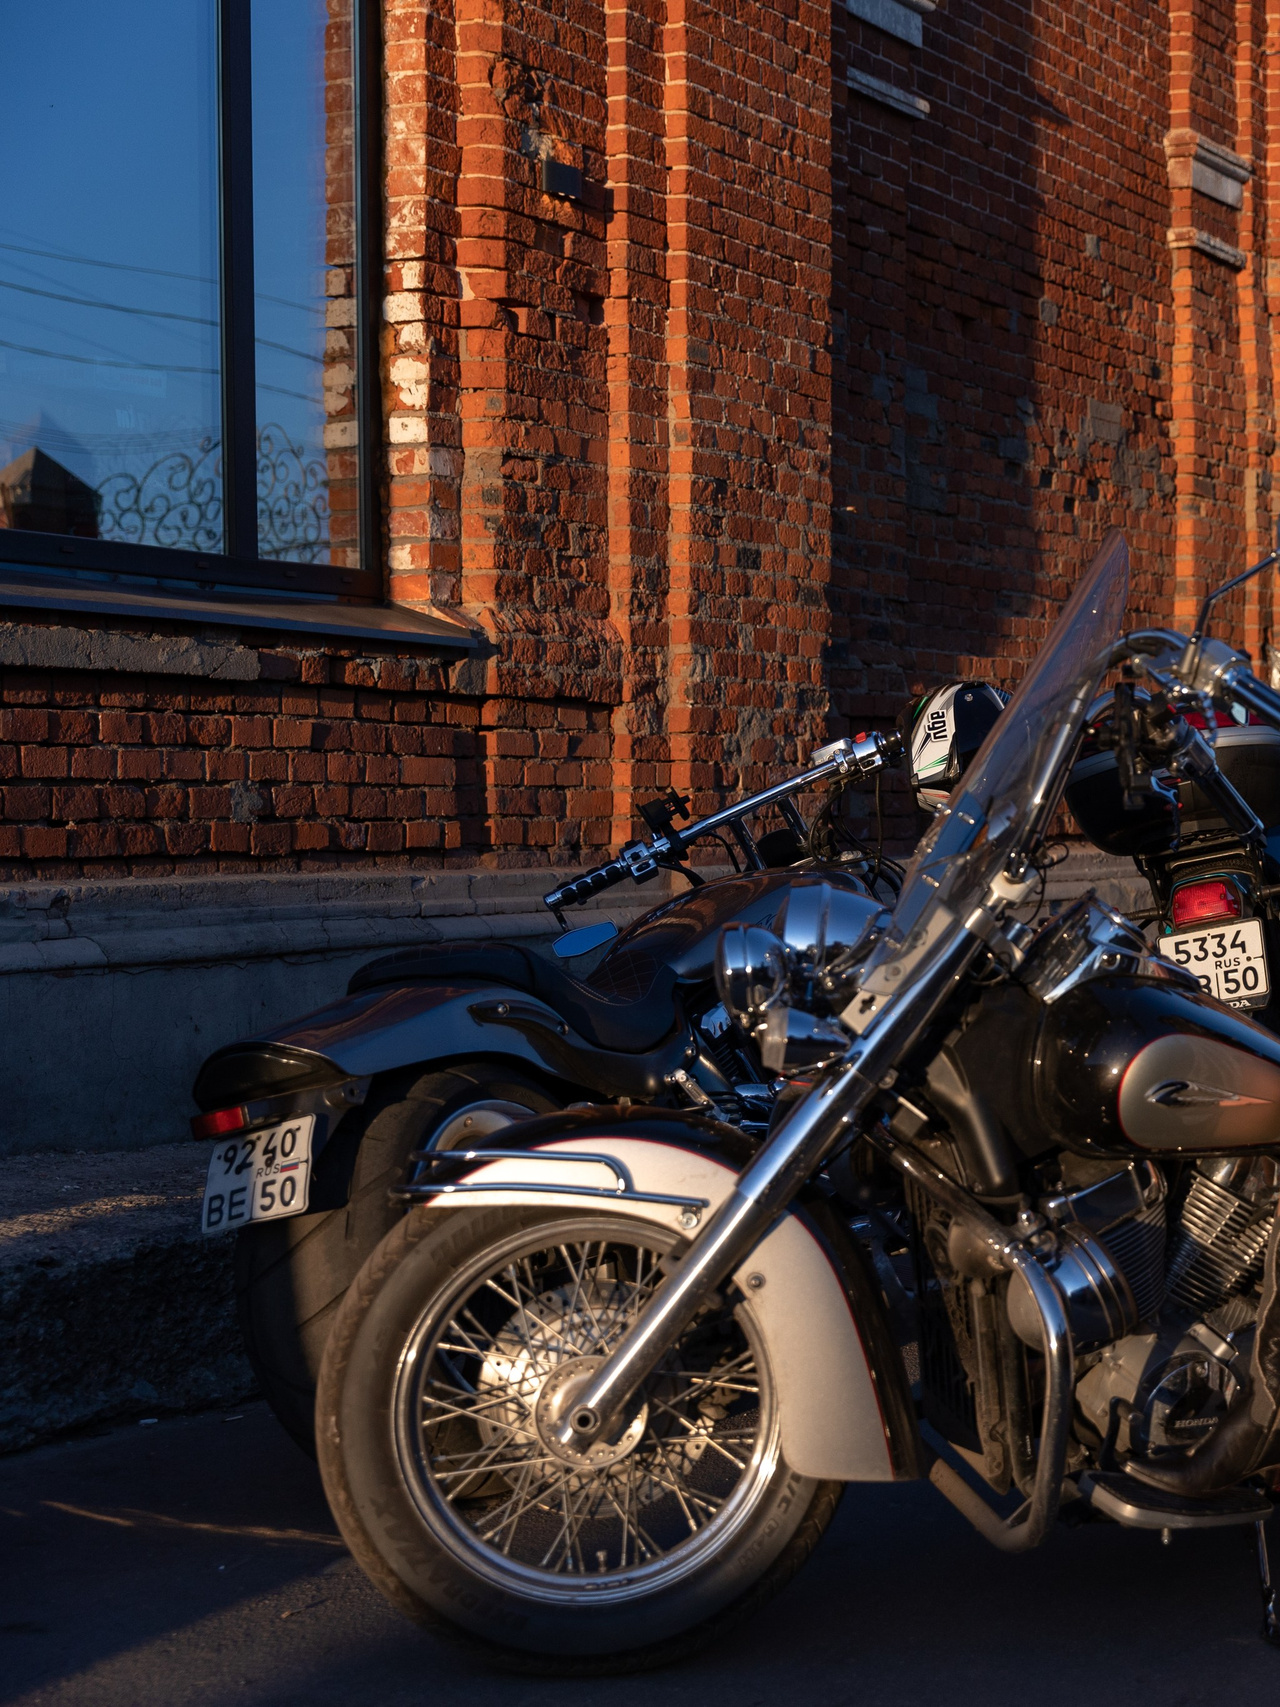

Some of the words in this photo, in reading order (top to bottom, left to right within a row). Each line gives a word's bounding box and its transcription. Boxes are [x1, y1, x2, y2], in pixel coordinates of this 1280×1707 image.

[927, 710, 948, 740] agv
[1174, 930, 1247, 965] 5334
[1215, 957, 1241, 970] RUS
[1223, 966, 1259, 994] 50
[223, 1128, 298, 1175] 9240
[256, 1163, 281, 1178] RUS
[206, 1186, 247, 1228] BE
[260, 1176, 296, 1212] 50
[1174, 1417, 1218, 1428] HONDA
